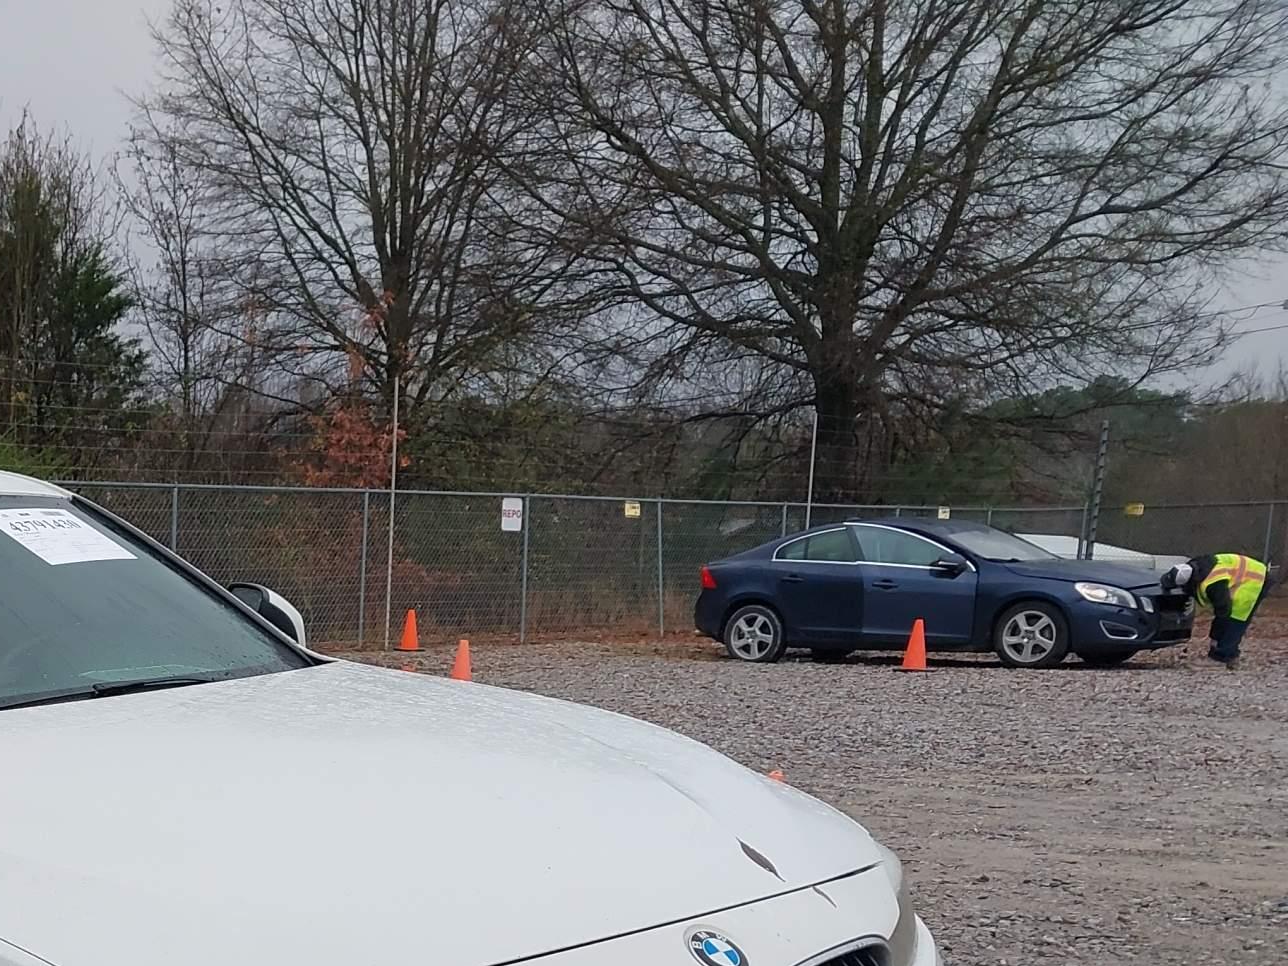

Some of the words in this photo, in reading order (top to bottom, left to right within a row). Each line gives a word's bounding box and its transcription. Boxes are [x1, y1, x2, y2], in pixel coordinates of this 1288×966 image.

[503, 509, 522, 518] REPO
[9, 519, 82, 532] 43791430
[692, 931, 728, 949] BMW
